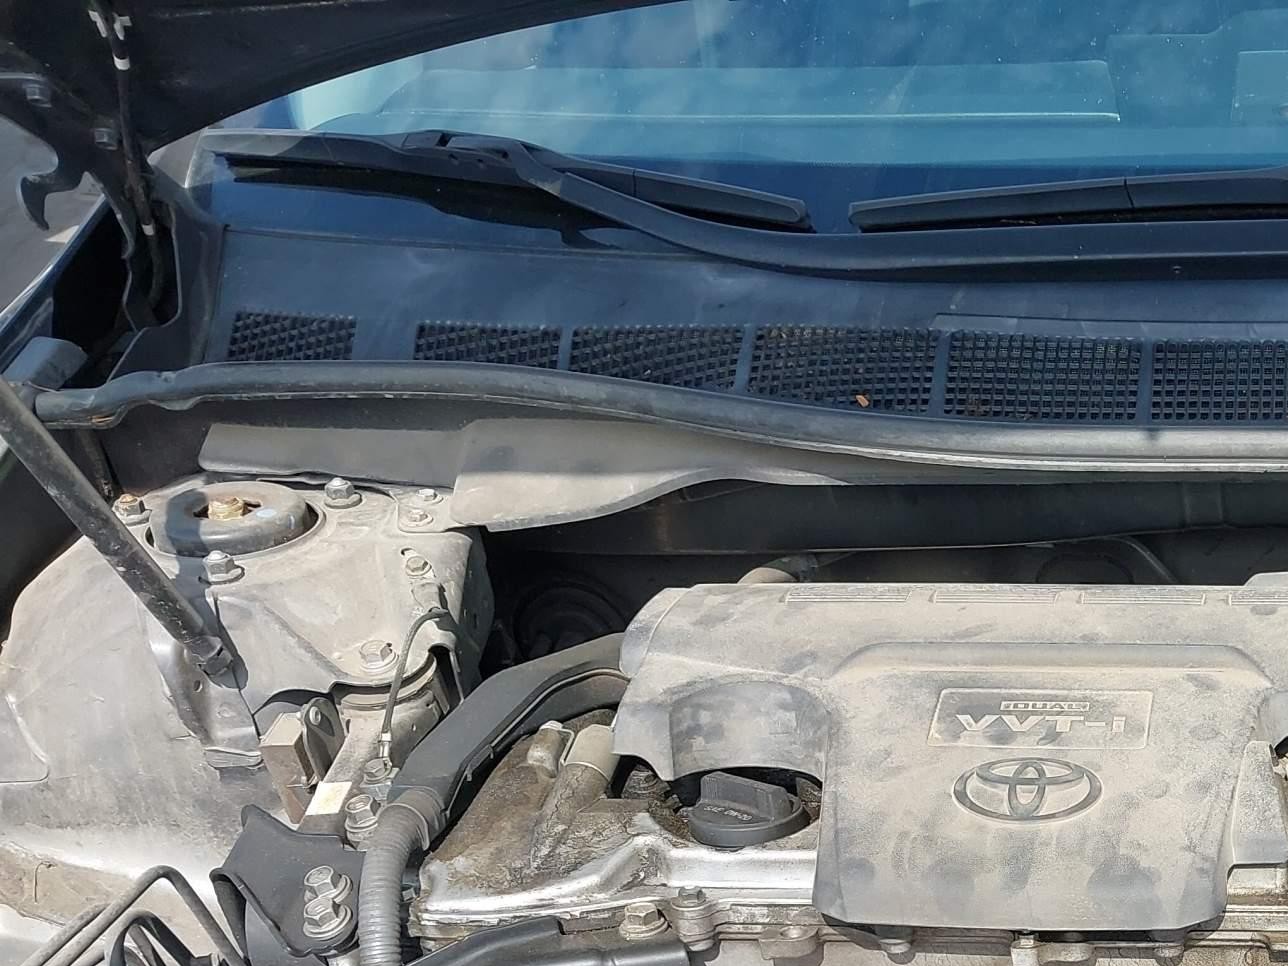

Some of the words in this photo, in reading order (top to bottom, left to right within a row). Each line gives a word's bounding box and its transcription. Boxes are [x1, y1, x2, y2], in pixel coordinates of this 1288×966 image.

[1012, 702, 1081, 711] DUAL
[956, 714, 1127, 733] VVT-i
[702, 804, 723, 813] SAE
